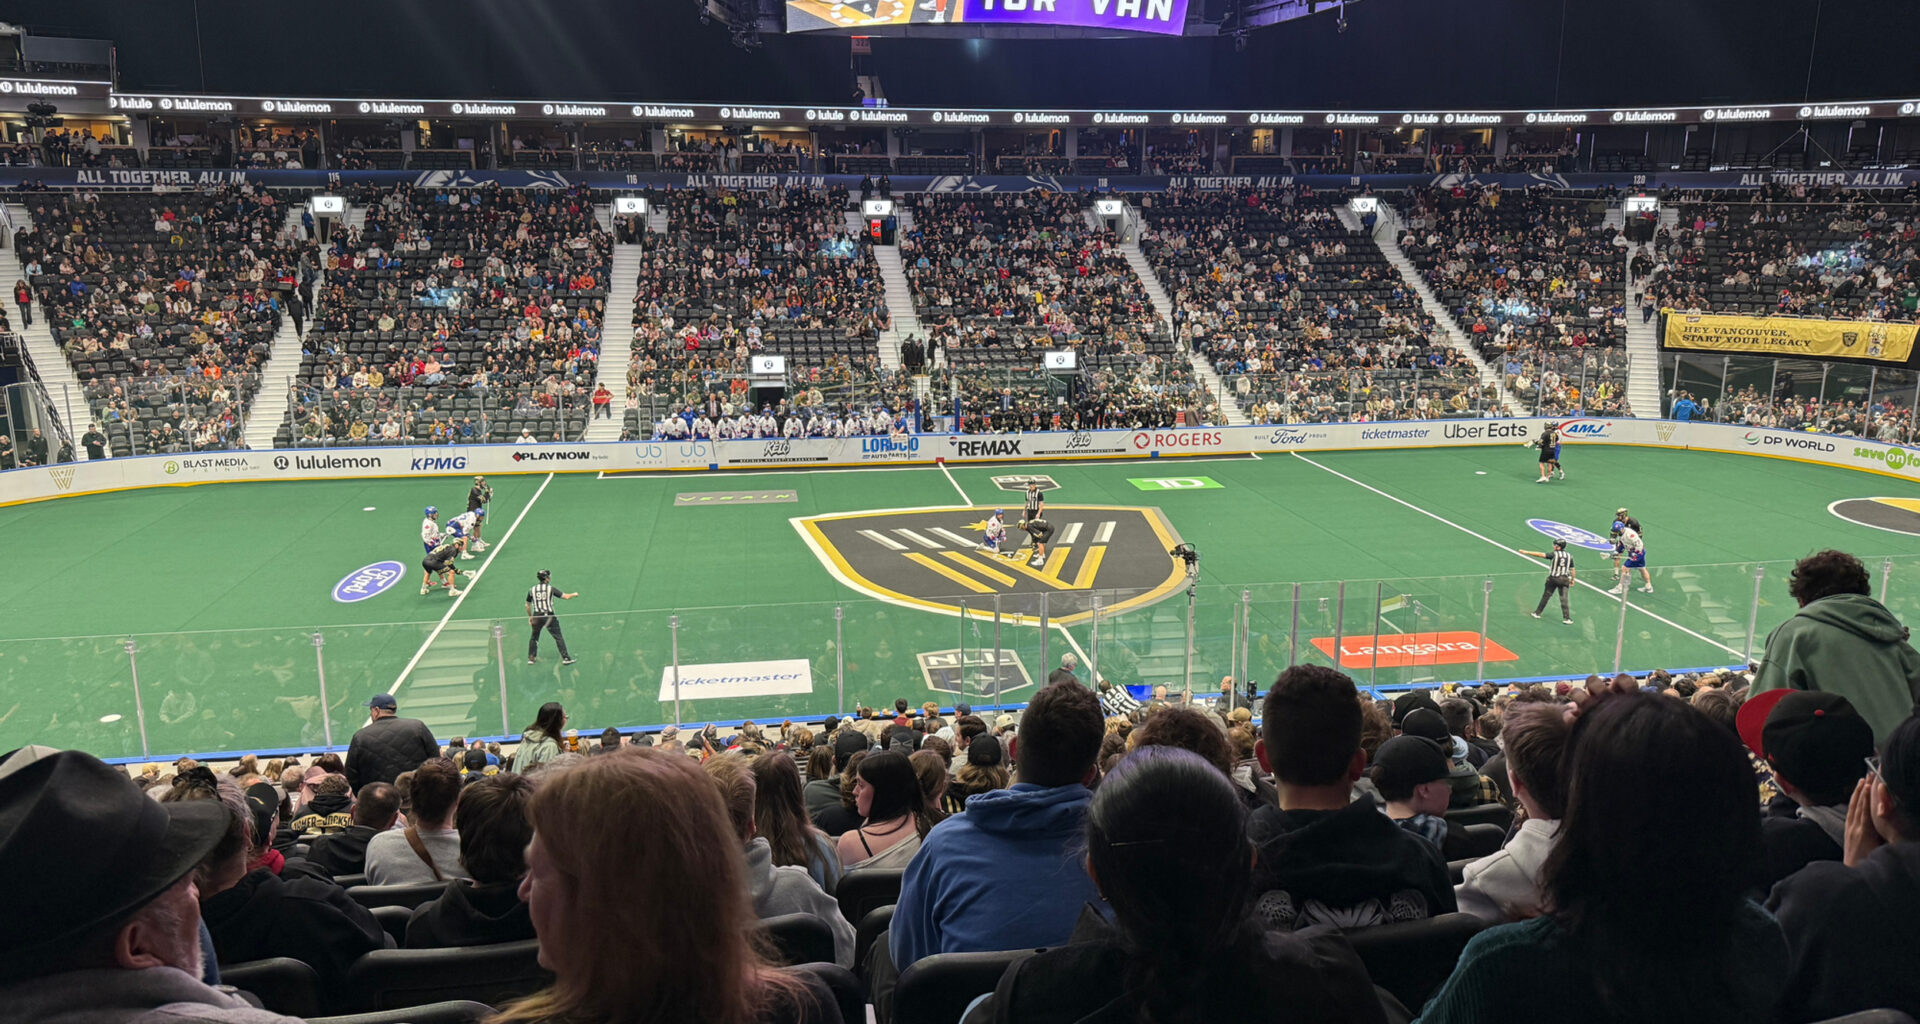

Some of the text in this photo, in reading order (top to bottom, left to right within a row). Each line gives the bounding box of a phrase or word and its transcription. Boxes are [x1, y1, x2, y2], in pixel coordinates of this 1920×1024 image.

[16, 82, 78, 96] lululemon
[175, 99, 233, 111] lululemon
[277, 101, 332, 112] lululemon
[372, 103, 424, 114] lululemon
[465, 104, 516, 116] lululemon
[556, 106, 606, 116] lululemon
[645, 106, 695, 118] lululemon
[732, 108, 780, 119] lululemon
[862, 110, 908, 122] lululemon
[1626, 111, 1677, 121] lululemon
[1717, 109, 1771, 120] lululemon
[1814, 106, 1871, 117] lululemon
[944, 112, 990, 122] lululemon
[1025, 112, 1070, 123] lululemon
[1104, 113, 1149, 124] lululemon
[1183, 114, 1227, 124] lululemon
[1260, 114, 1304, 124] lululemon
[1336, 114, 1380, 124] lululemon
[1456, 114, 1502, 124] lululemon
[1538, 112, 1587, 122] lululemon
[77, 171, 106, 184] ALL
[109, 171, 195, 184] TOGETHER.
[198, 171, 223, 184] ALL
[626, 174, 638, 184] 116
[686, 175, 709, 187] ALL
[784, 175, 807, 189] ALL
[1169, 177, 1188, 188] ALL
[1256, 176, 1277, 188] ALL
[1633, 175, 1646, 185] 120
[1740, 172, 1904, 186] ALL TOGETHER. ALL IN.
[1684, 326, 1791, 339] HEY VANCOUVER,
[1682, 334, 1813, 349] START YOUR LEGACY
[1361, 428, 1431, 440] ticketmaster
[1443, 424, 1528, 439] Uber Eats
[1566, 424, 1606, 434] AMJ
[1155, 432, 1222, 448] ROGERS
[1270, 428, 1308, 444] Ford
[1763, 436, 1836, 452] DP WORLD
[521, 451, 591, 462] PLAYNOW
[1854, 447, 1920, 468] save on fo
[183, 459, 214, 469] BLAST
[215, 458, 249, 467] MEDIA
[296, 456, 382, 471] lululemon
[411, 457, 467, 471] KPMG
[1142, 480, 1205, 489] TD
[1340, 642, 1481, 657] Langara
[928, 652, 1011, 666] NLL
